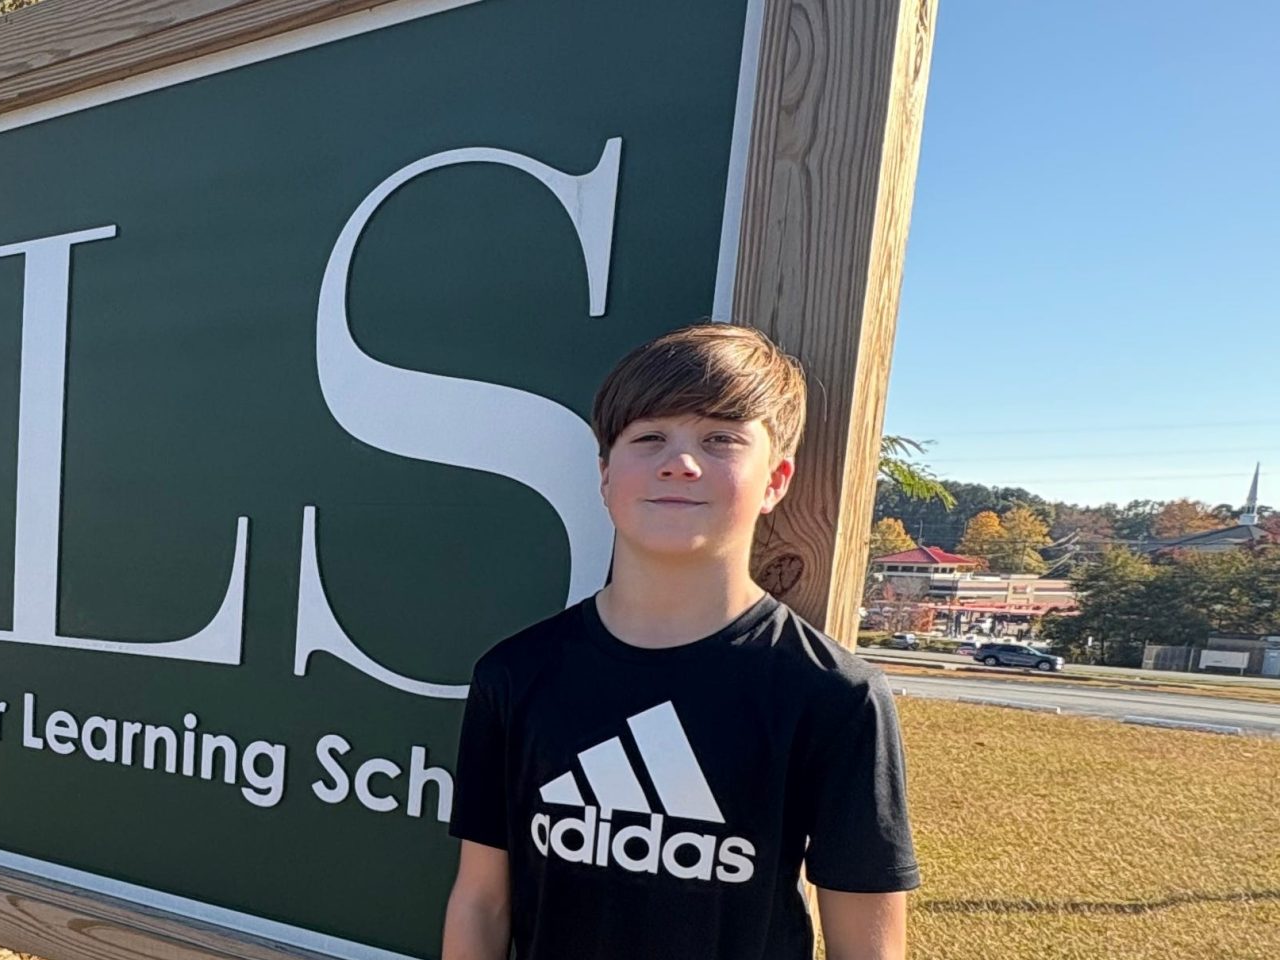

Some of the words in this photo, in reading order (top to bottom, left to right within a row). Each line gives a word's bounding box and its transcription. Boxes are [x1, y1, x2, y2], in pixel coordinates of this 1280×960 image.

[23, 692, 286, 808] Learning
[311, 733, 455, 824] Sch
[530, 804, 756, 883] adidas
